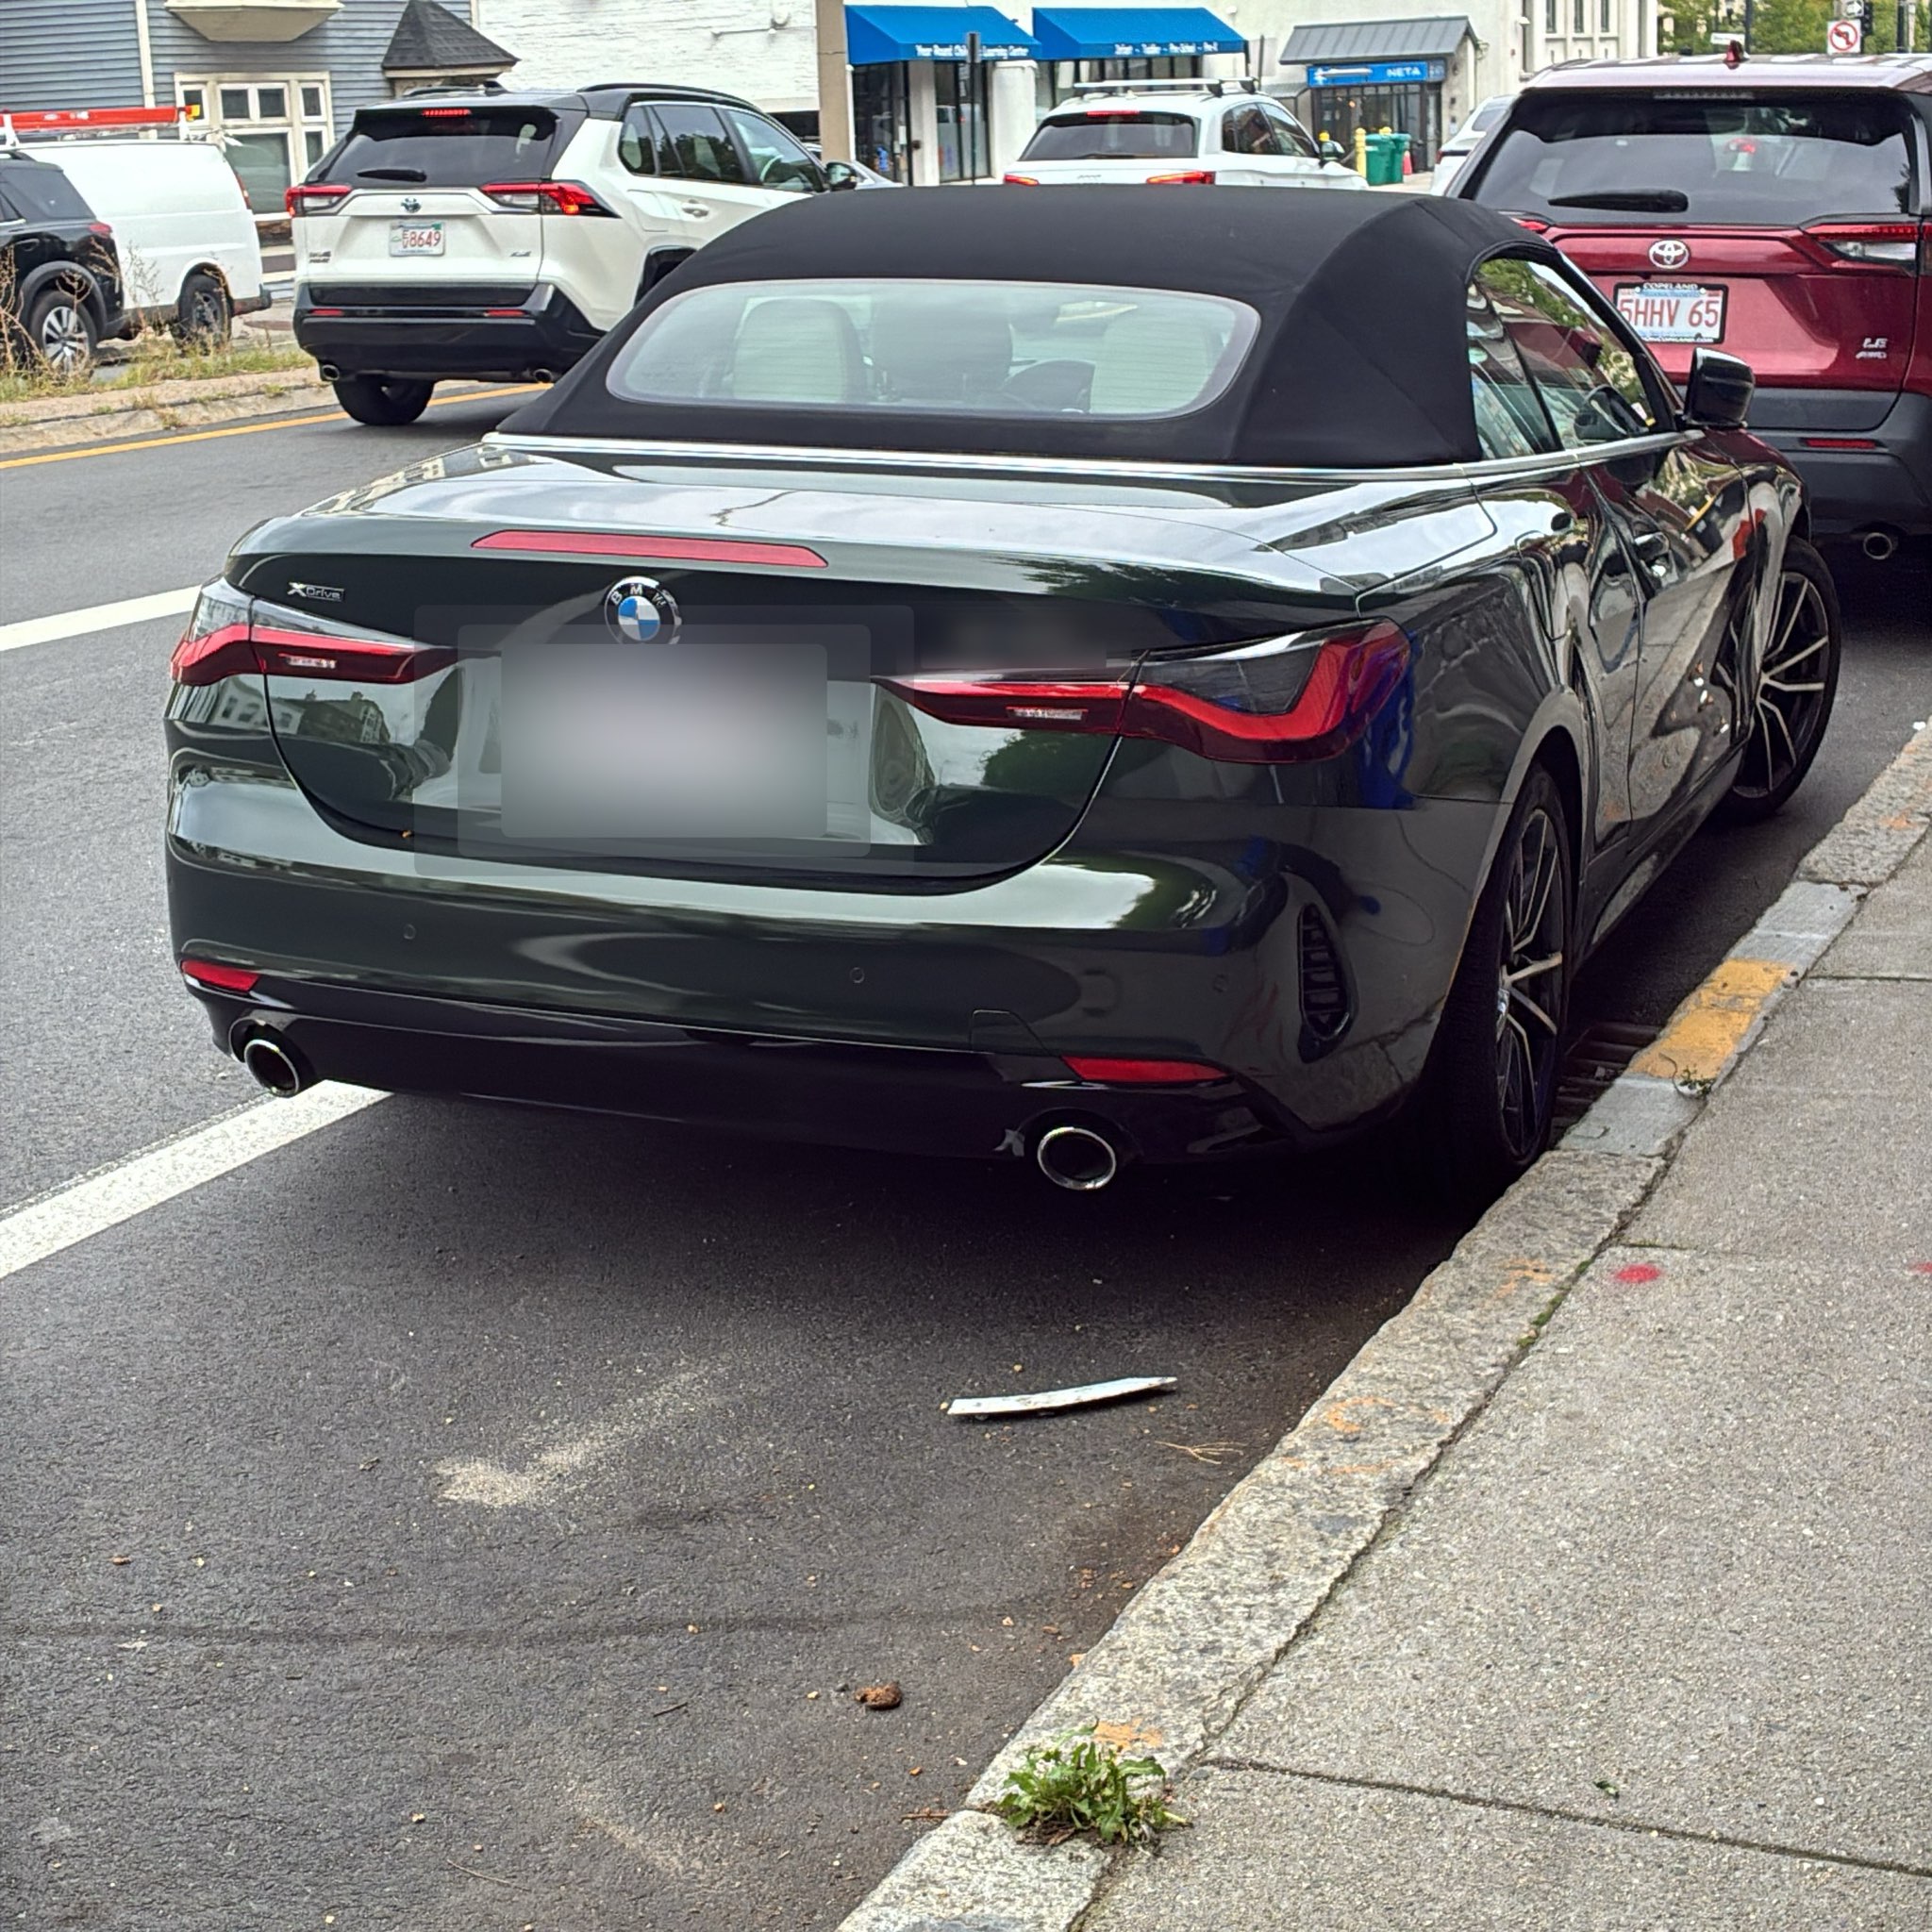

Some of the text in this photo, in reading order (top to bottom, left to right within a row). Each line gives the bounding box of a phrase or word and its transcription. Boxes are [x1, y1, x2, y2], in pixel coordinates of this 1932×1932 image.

[1386, 67, 1421, 77] NETA
[409, 231, 441, 247] 8649
[1620, 299, 1720, 327] 5HHV 65
[1862, 338, 1888, 348] LE
[610, 583, 666, 606] BMW
